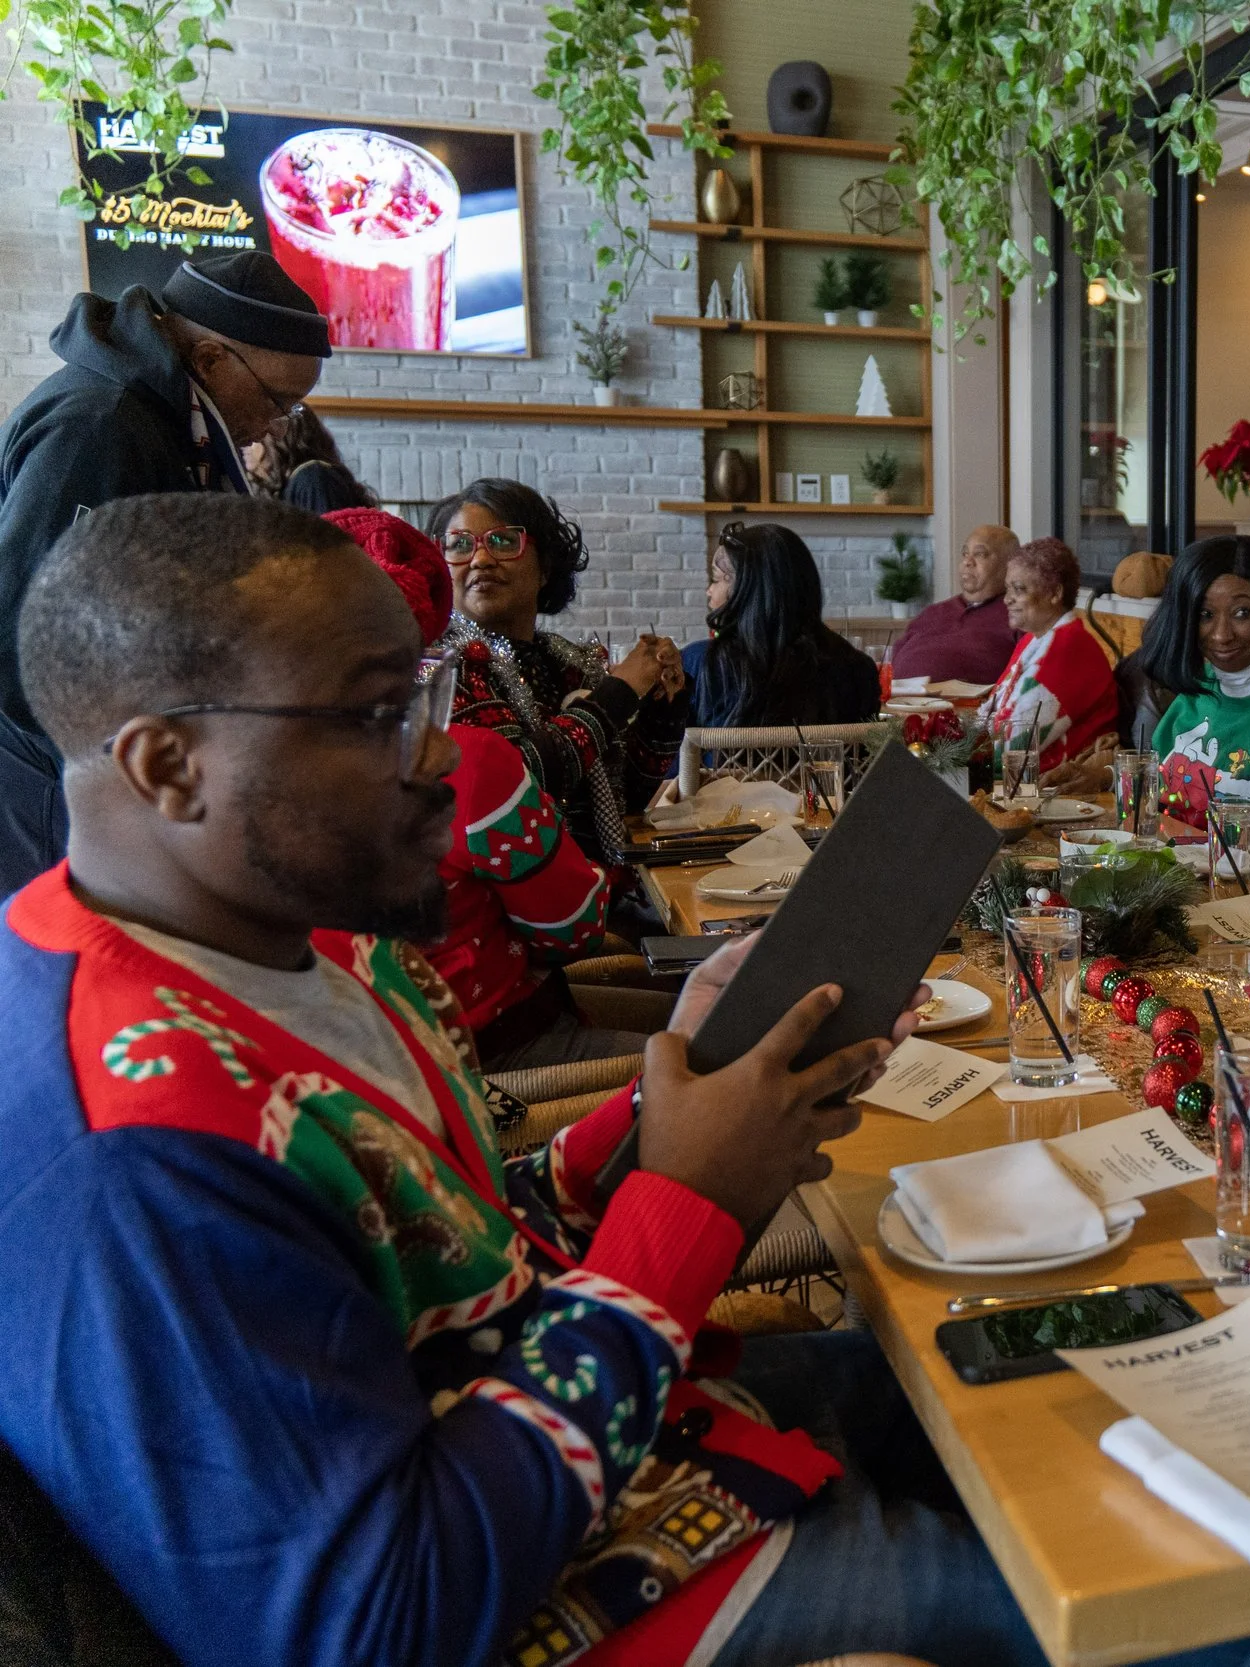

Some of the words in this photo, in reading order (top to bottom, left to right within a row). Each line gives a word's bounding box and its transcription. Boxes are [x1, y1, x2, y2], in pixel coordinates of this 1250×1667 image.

[99, 116, 224, 144] HAST
[96, 229, 158, 243] DUING
[211, 235, 256, 249] HOUR
[922, 1068, 980, 1109] HARVEST
[1140, 1128, 1204, 1174] HARVEST
[1103, 1327, 1235, 1370] HARVEST
